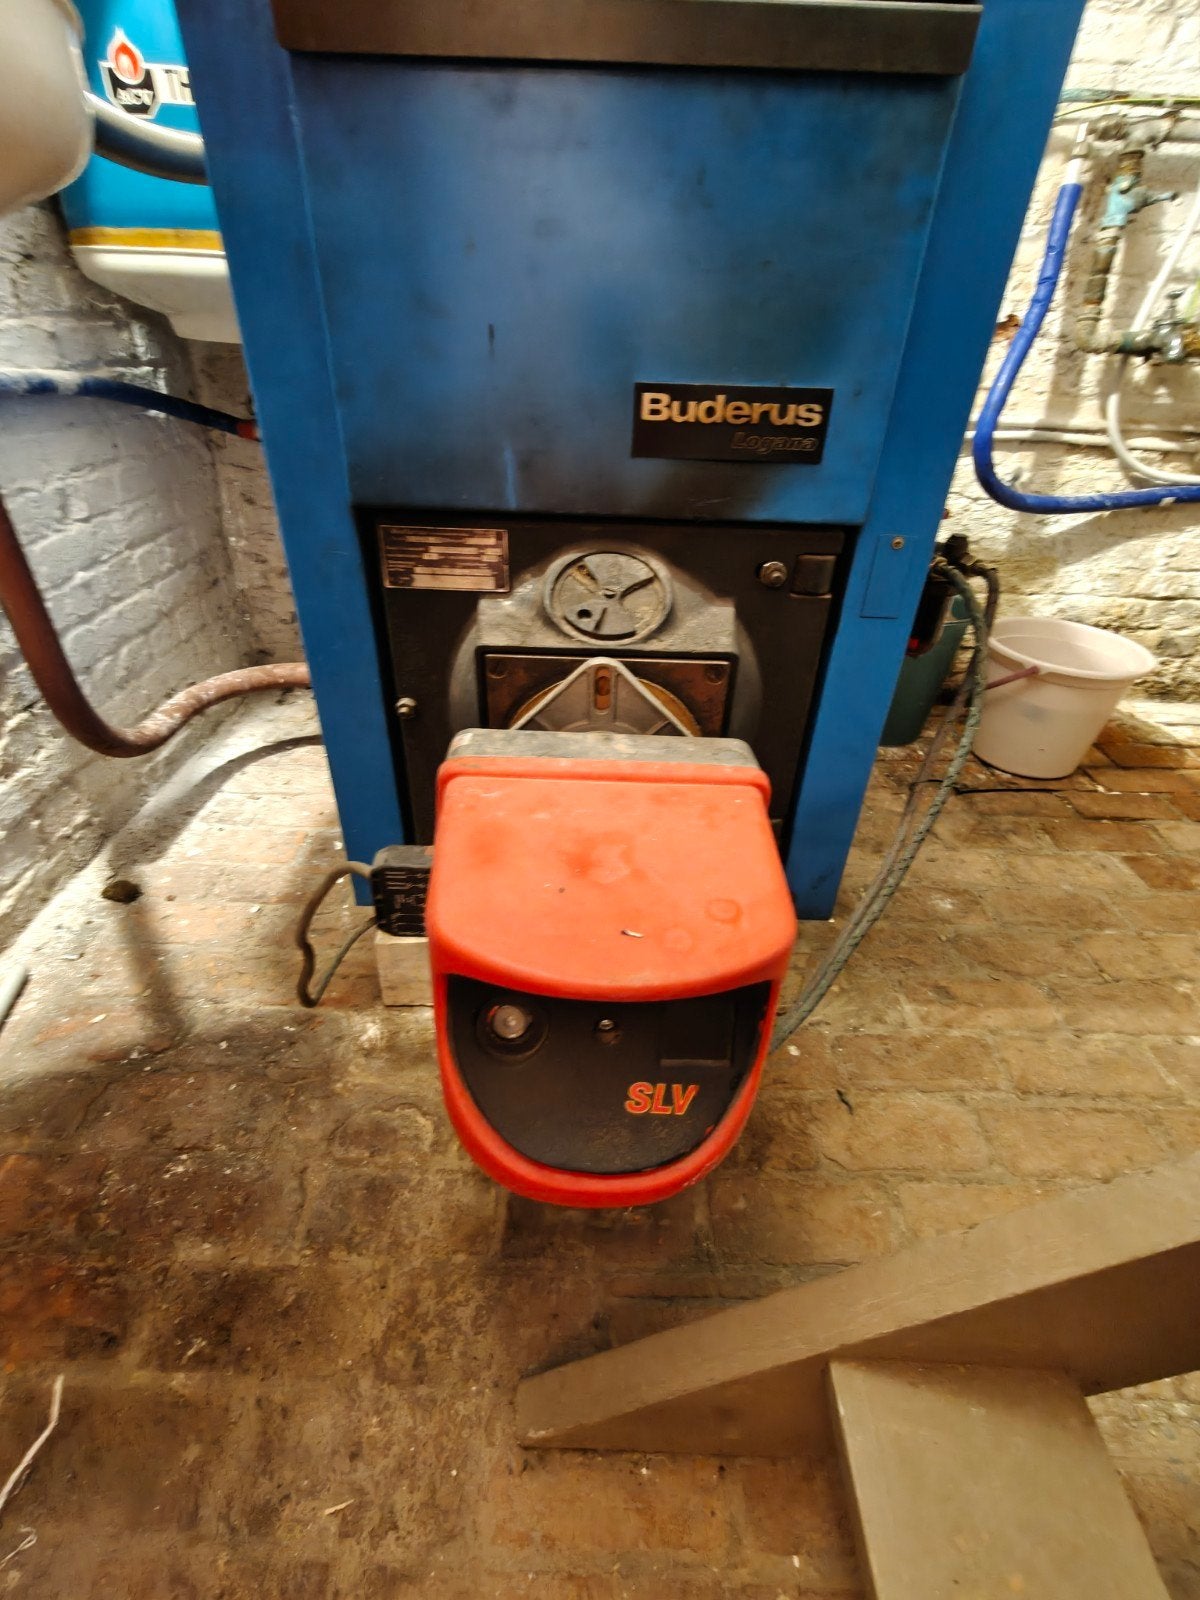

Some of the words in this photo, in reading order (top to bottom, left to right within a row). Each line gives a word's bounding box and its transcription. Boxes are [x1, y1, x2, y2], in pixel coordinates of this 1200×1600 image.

[641, 392, 824, 427] Buderus
[731, 431, 819, 455] Logana
[625, 1082, 699, 1115] SLV
